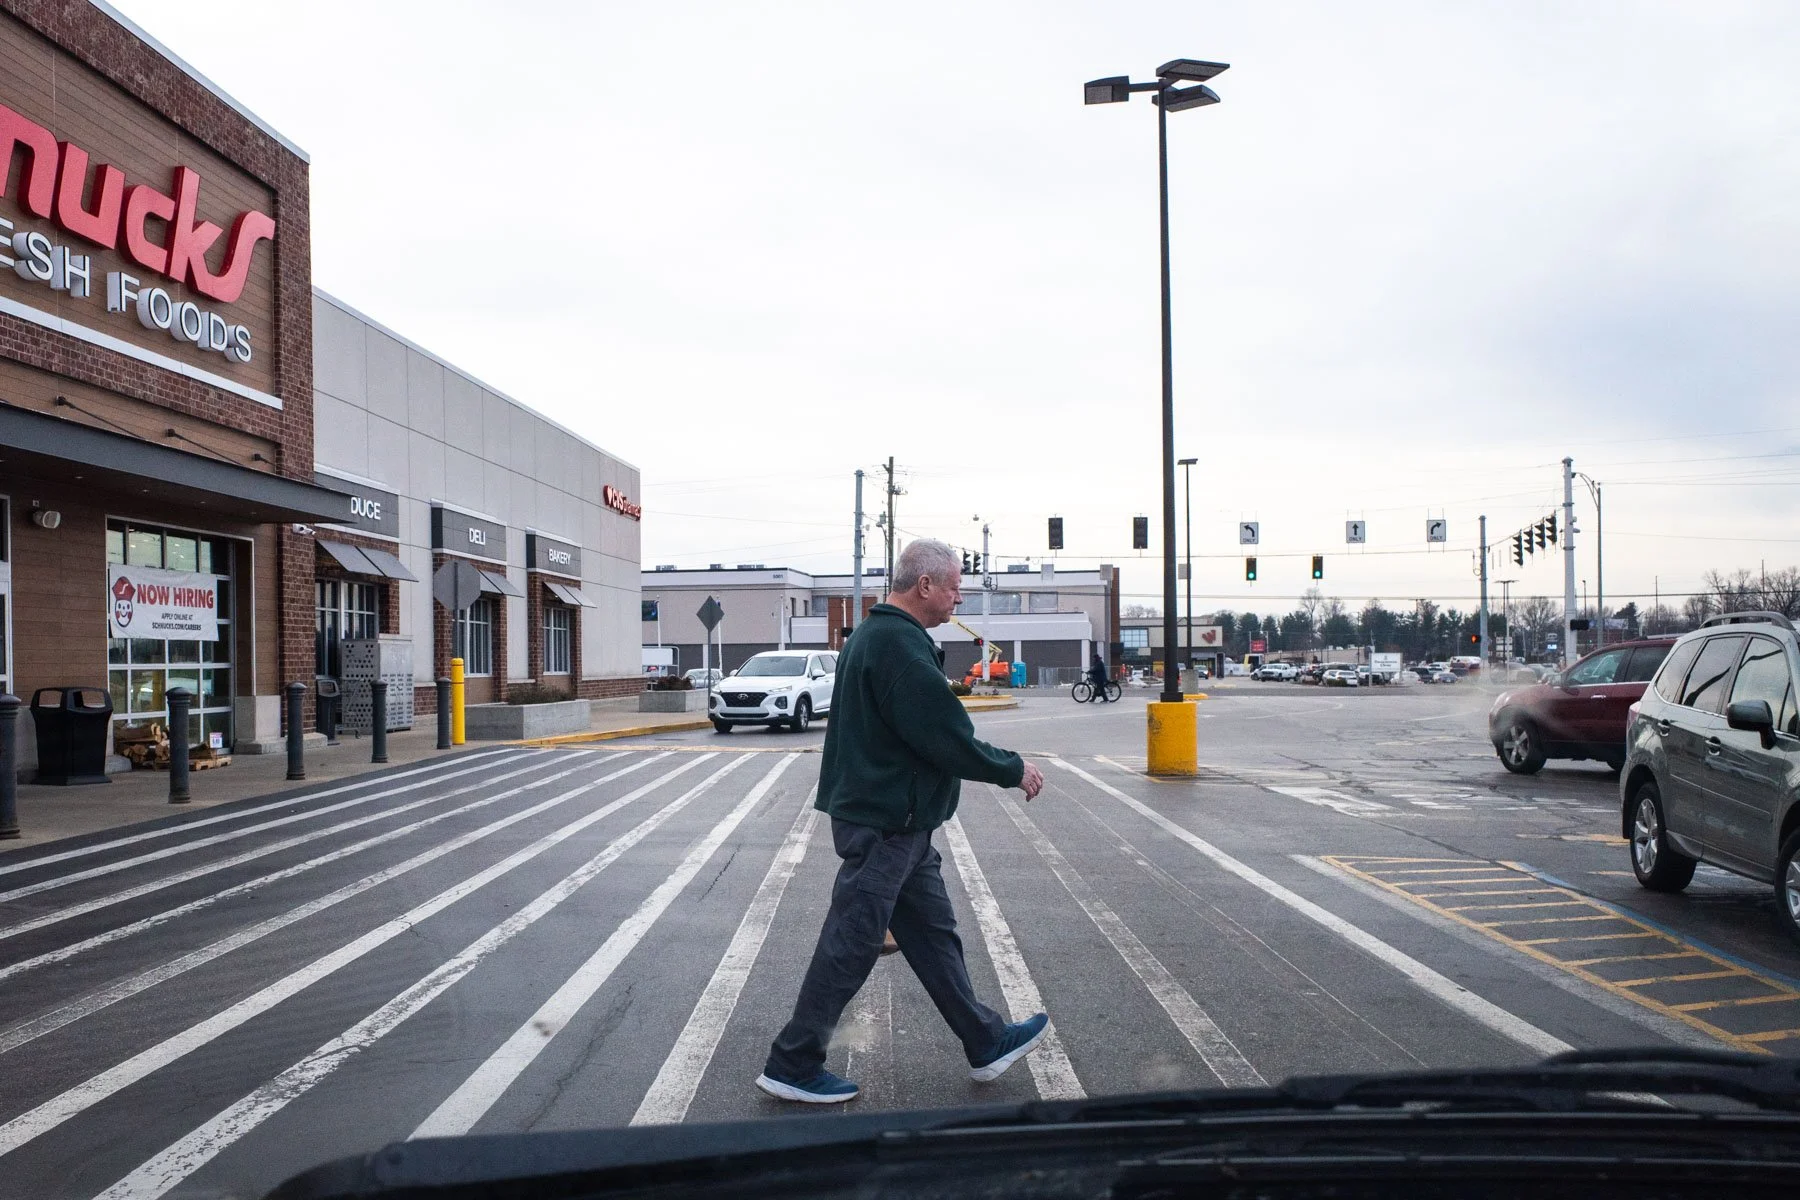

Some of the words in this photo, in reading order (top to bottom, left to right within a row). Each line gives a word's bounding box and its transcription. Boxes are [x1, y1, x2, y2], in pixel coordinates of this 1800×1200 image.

[108, 271, 252, 364] FOODS
[350, 496, 381, 520] DUCE
[612, 488, 625, 511] CVS
[469, 527, 486, 546] DELI
[548, 548, 571, 565] BAKERY
[136, 583, 170, 606] NOW
[173, 586, 214, 609] HIRING
